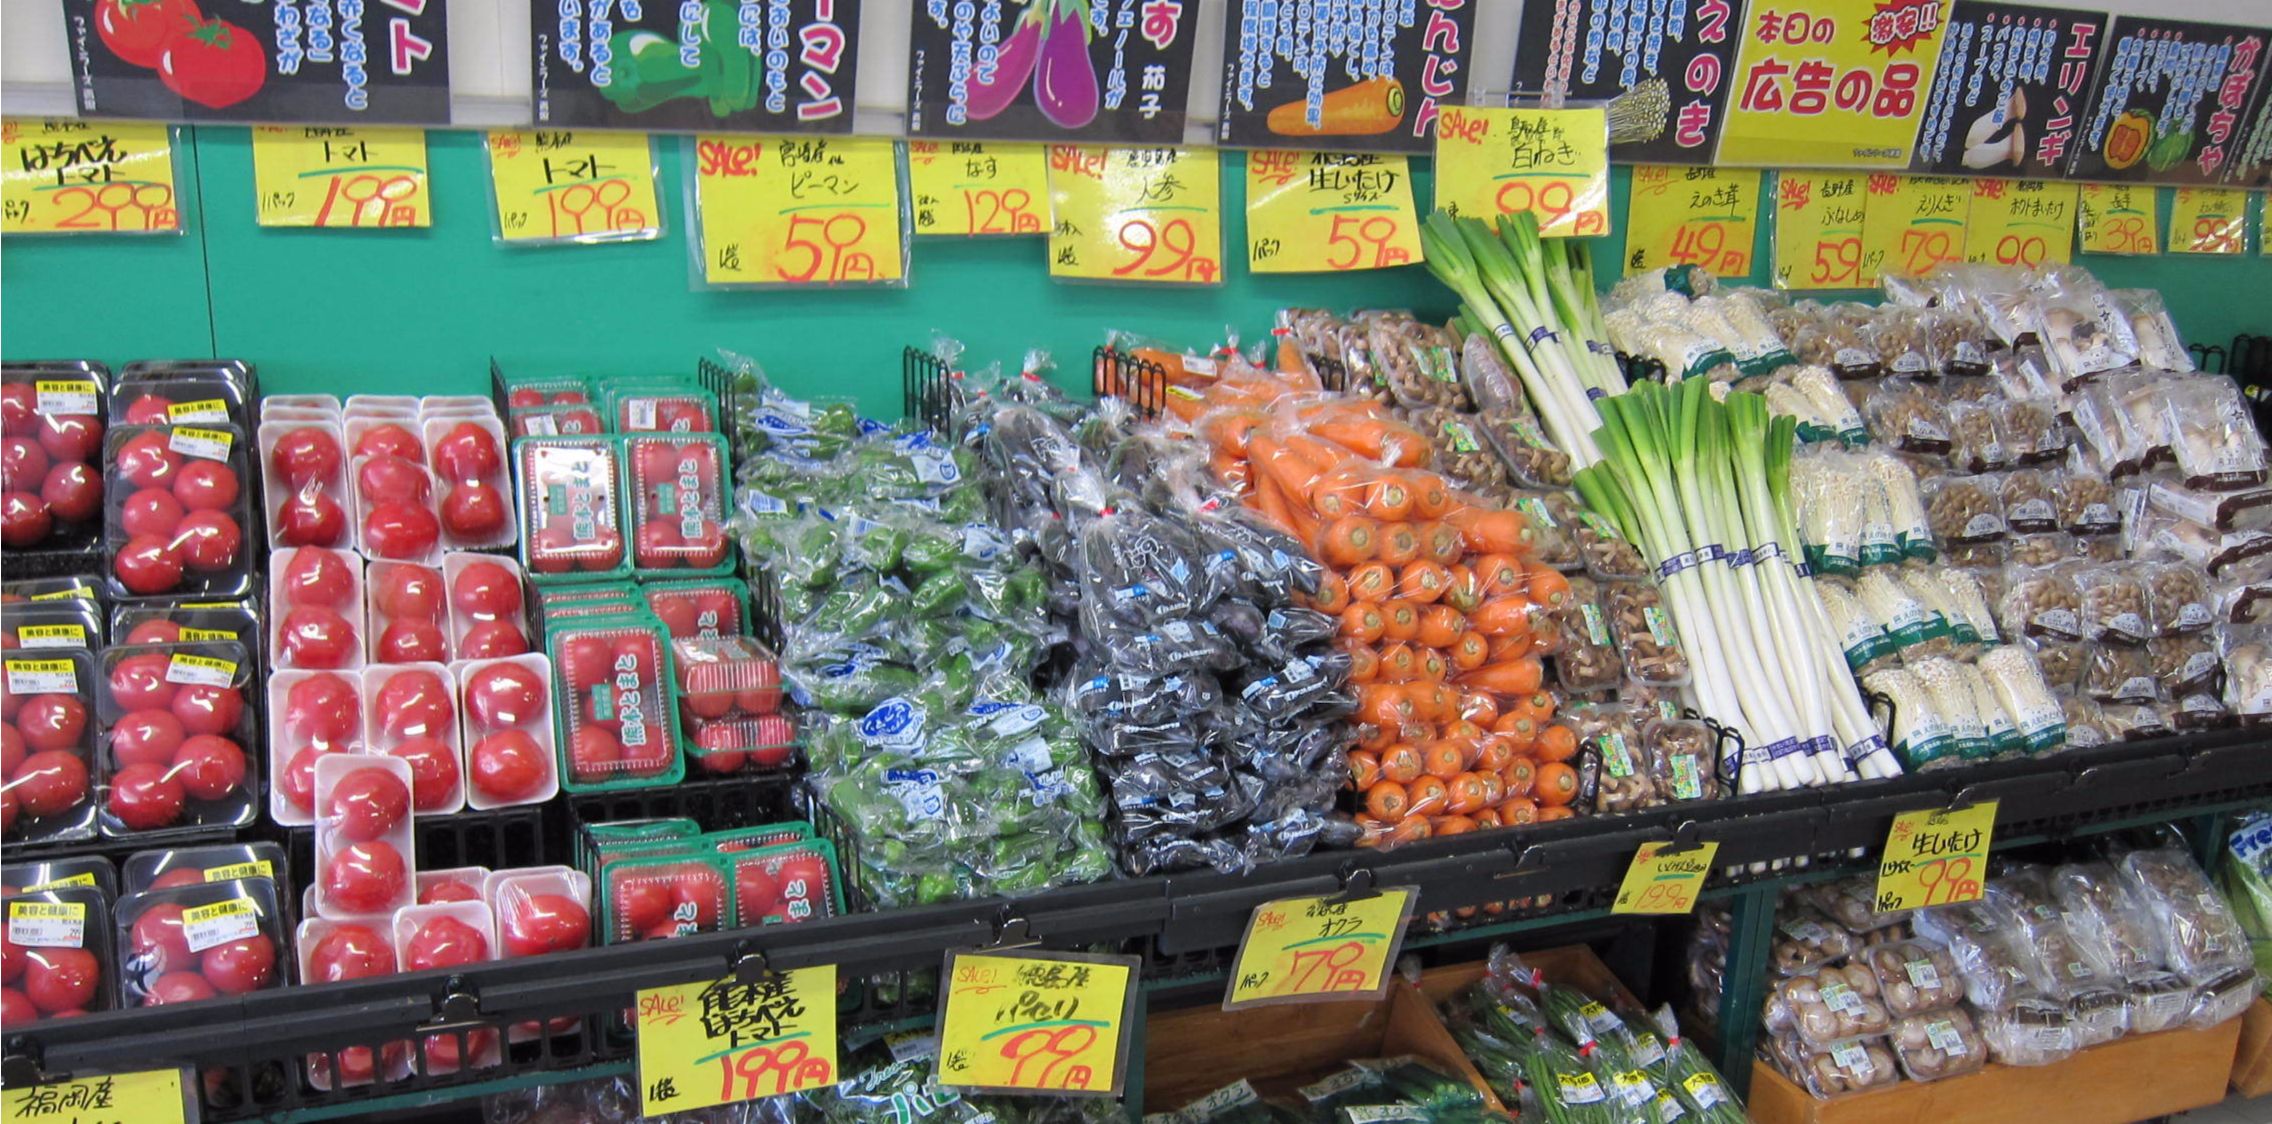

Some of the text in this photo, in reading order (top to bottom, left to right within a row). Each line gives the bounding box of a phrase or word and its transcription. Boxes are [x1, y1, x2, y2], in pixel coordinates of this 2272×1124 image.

[275, 0, 304, 75] わざが
[308, 0, 334, 62] なる」
[738, 0, 762, 56] には、
[1329, 0, 1349, 58] 予防や
[1756, 10, 1836, 45] 本日の
[766, 0, 790, 114] おいのもと
[1675, 0, 1731, 148] えのき
[1739, 57, 1921, 118] 広告の品
[1138, 65, 1167, 119] 茄子
[2036, 22, 2097, 167] エリンギ
[2197, 35, 2262, 176] かぼちゃ
[324, 140, 378, 163] トマト
[1512, 141, 1581, 168] 白ねぎ
[57, 165, 126, 185] トマト
[544, 154, 616, 184] トマト
[966, 156, 998, 179] なす
[1309, 168, 1400, 193] 生しいたけ
[790, 169, 860, 199] ピーマン
[1135, 172, 1187, 203] 人参
[1690, 184, 1740, 217] えのき茸
[1916, 195, 1962, 217] えりんぎ
[1912, 829, 1983, 857] 生しいたけ
[2230, 827, 2272, 858] Fre
[18, 905, 81, 916] 美容と健康に
[191, 902, 249, 920] 美容と健康に
[1318, 917, 1363, 938] オクラ
[995, 990, 1080, 1023] パセリ
[730, 1020, 798, 1049] トマト
[15, 1075, 115, 1118] 福岡産
